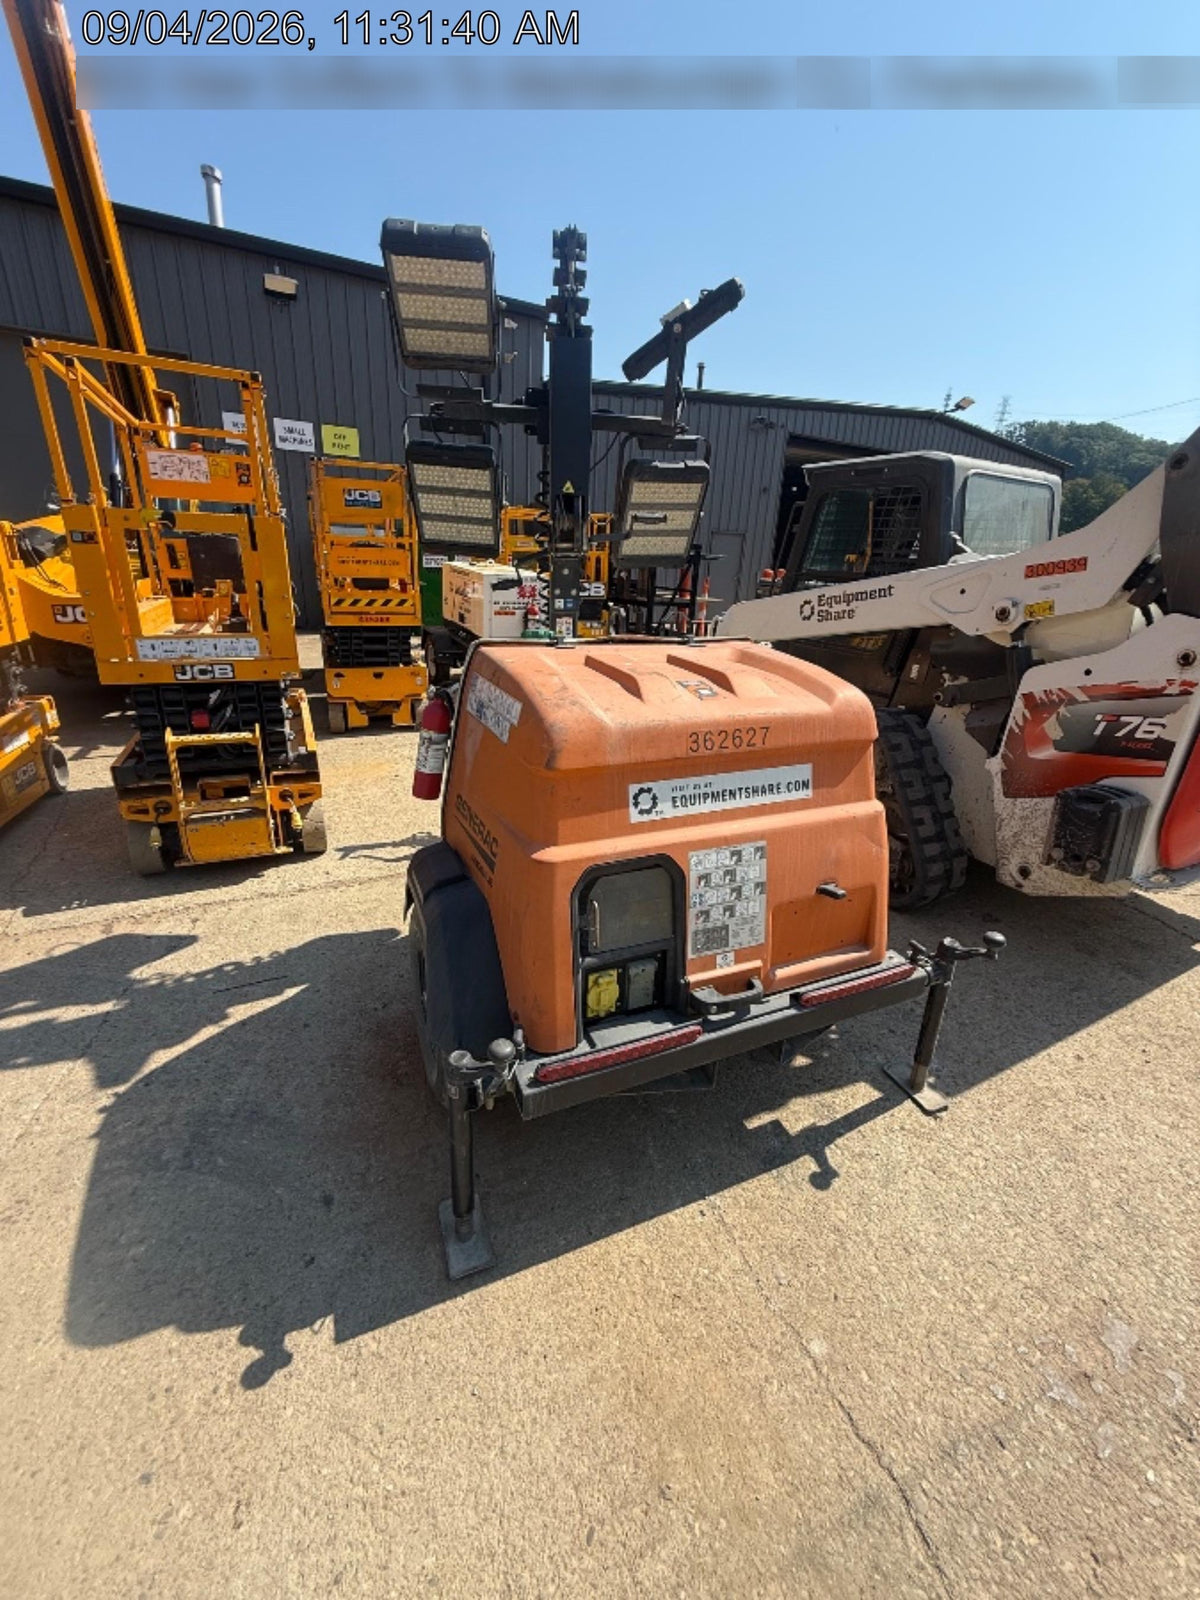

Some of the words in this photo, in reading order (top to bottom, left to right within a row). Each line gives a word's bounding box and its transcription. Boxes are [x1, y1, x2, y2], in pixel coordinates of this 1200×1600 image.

[344, 489, 381, 502] JCB
[580, 582, 606, 597] CB
[817, 584, 895, 608] Equipment
[817, 608, 856, 622] Share
[175, 664, 235, 680] JCB
[1093, 713, 1168, 739] T76
[689, 726, 771, 753] 362627
[15, 761, 37, 785] JCB
[671, 778, 811, 809] EQUIPMENTSHARE.COM
